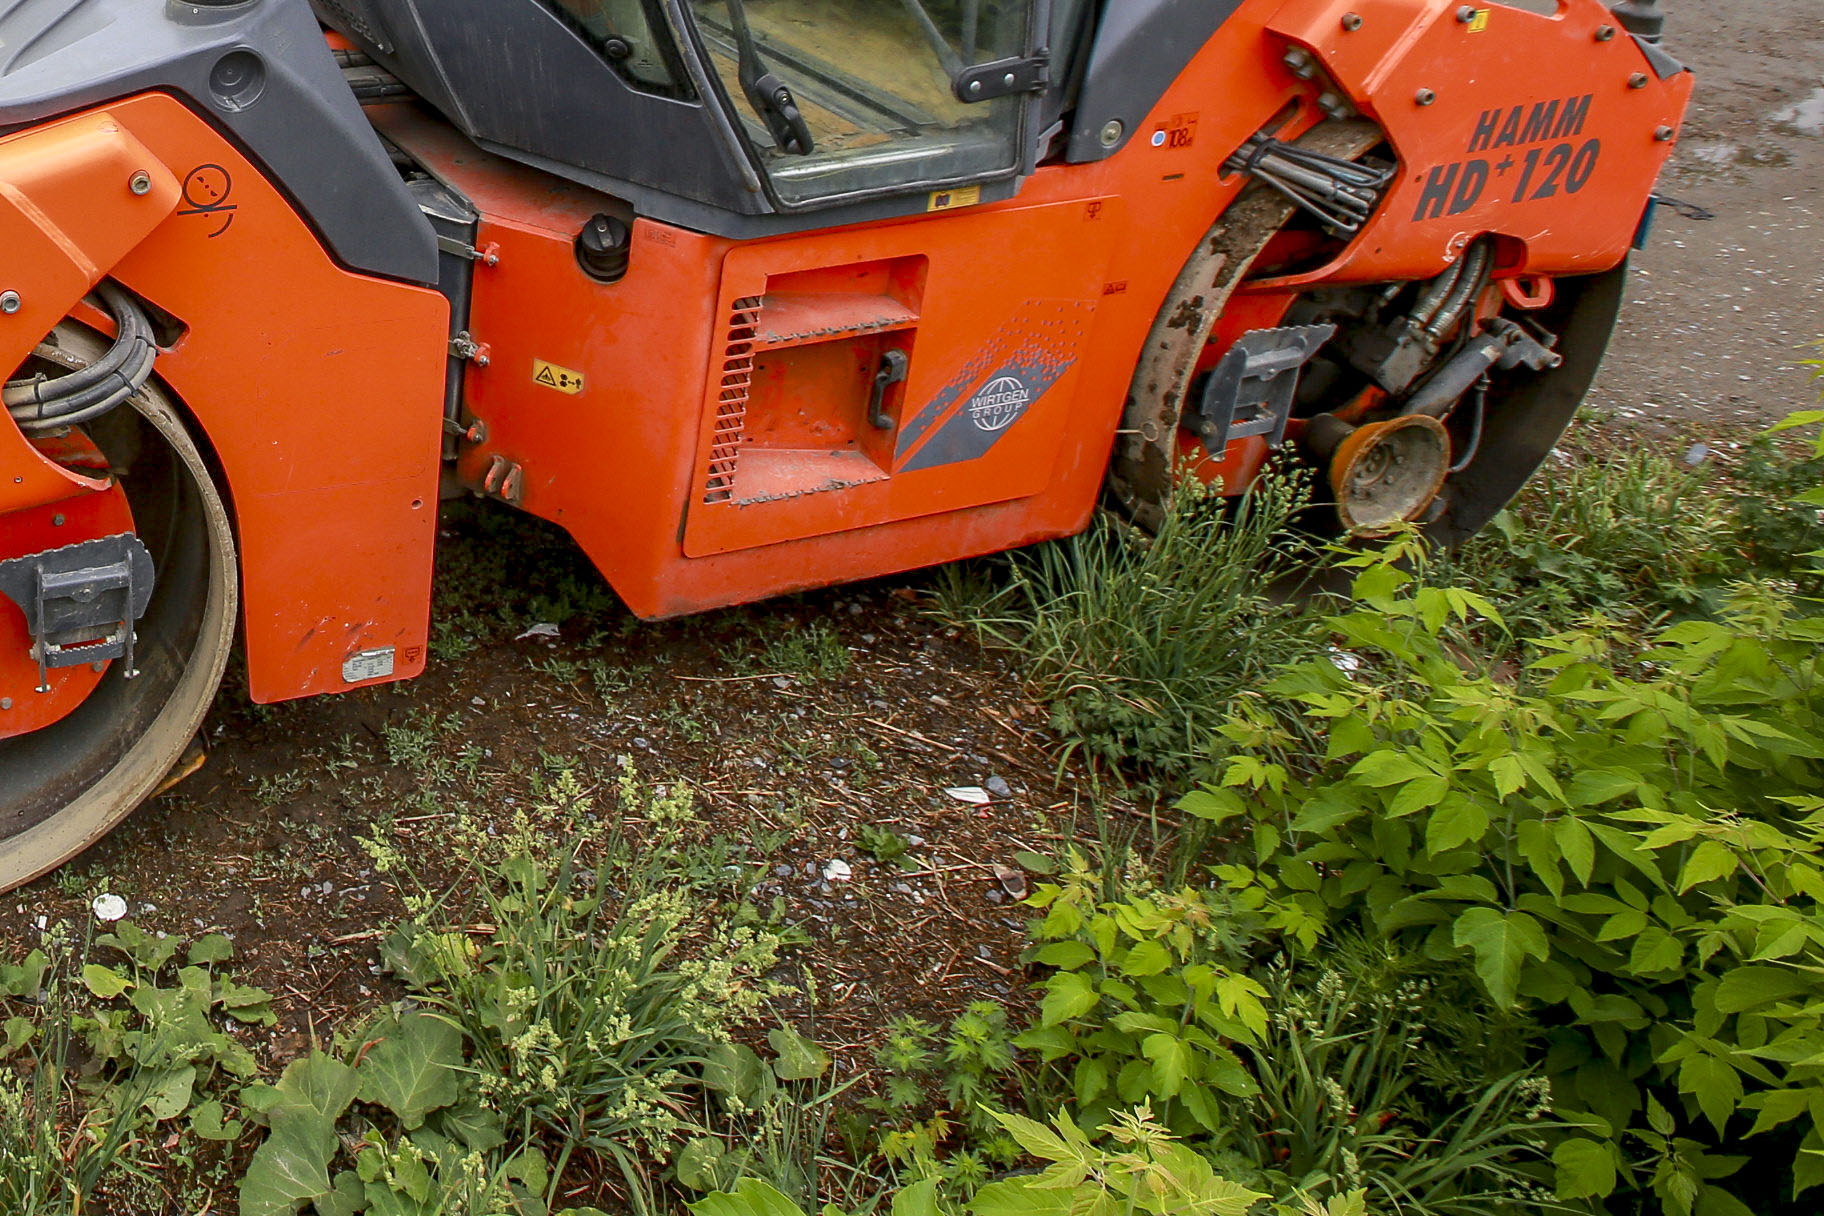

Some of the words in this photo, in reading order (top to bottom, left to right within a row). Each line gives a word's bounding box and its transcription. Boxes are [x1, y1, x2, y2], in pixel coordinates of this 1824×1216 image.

[1466, 93, 1594, 154] HAMM
[971, 388, 1030, 408] WIRTGEN
[972, 402, 1023, 419] GROUP
